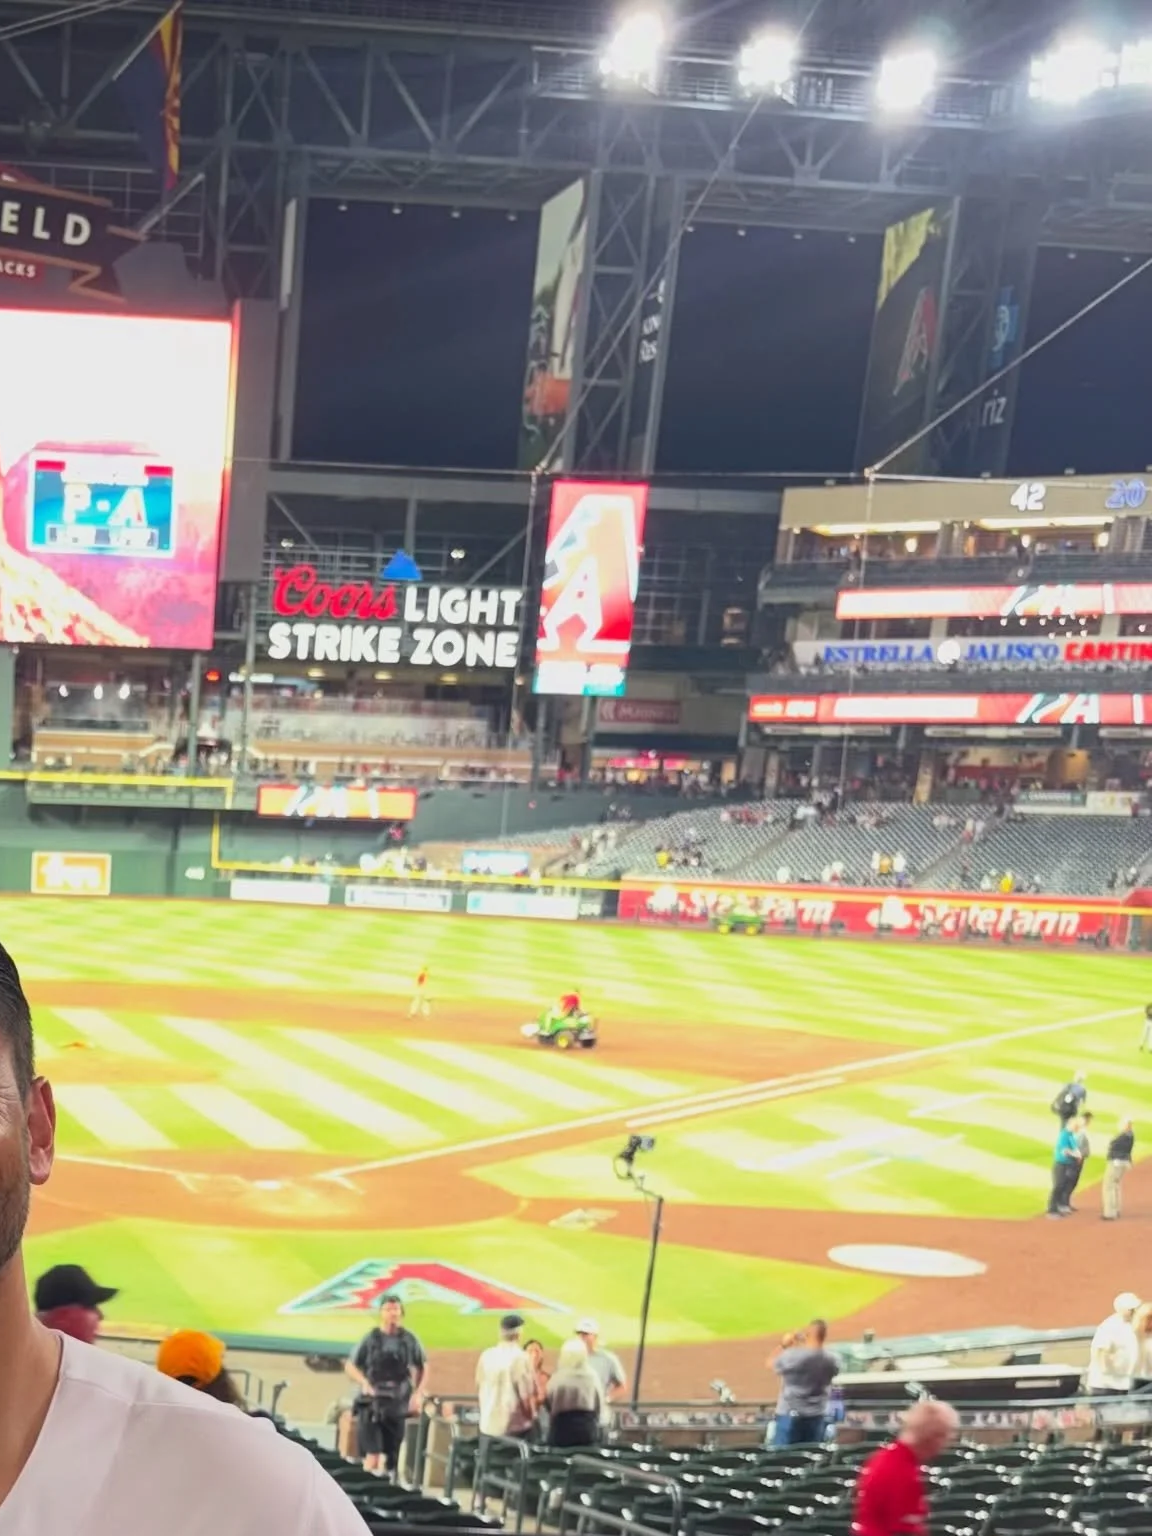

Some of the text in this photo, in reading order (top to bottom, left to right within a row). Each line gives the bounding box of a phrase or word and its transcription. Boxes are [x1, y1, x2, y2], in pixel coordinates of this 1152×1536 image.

[1010, 482, 1046, 511] 42
[1105, 479, 1145, 509] 20
[273, 564, 524, 626] Coors LIGHT
[268, 622, 520, 668] STRIKE ZONE
[823, 644, 933, 664] ESTRELLA
[963, 642, 1060, 661] JALISCO
